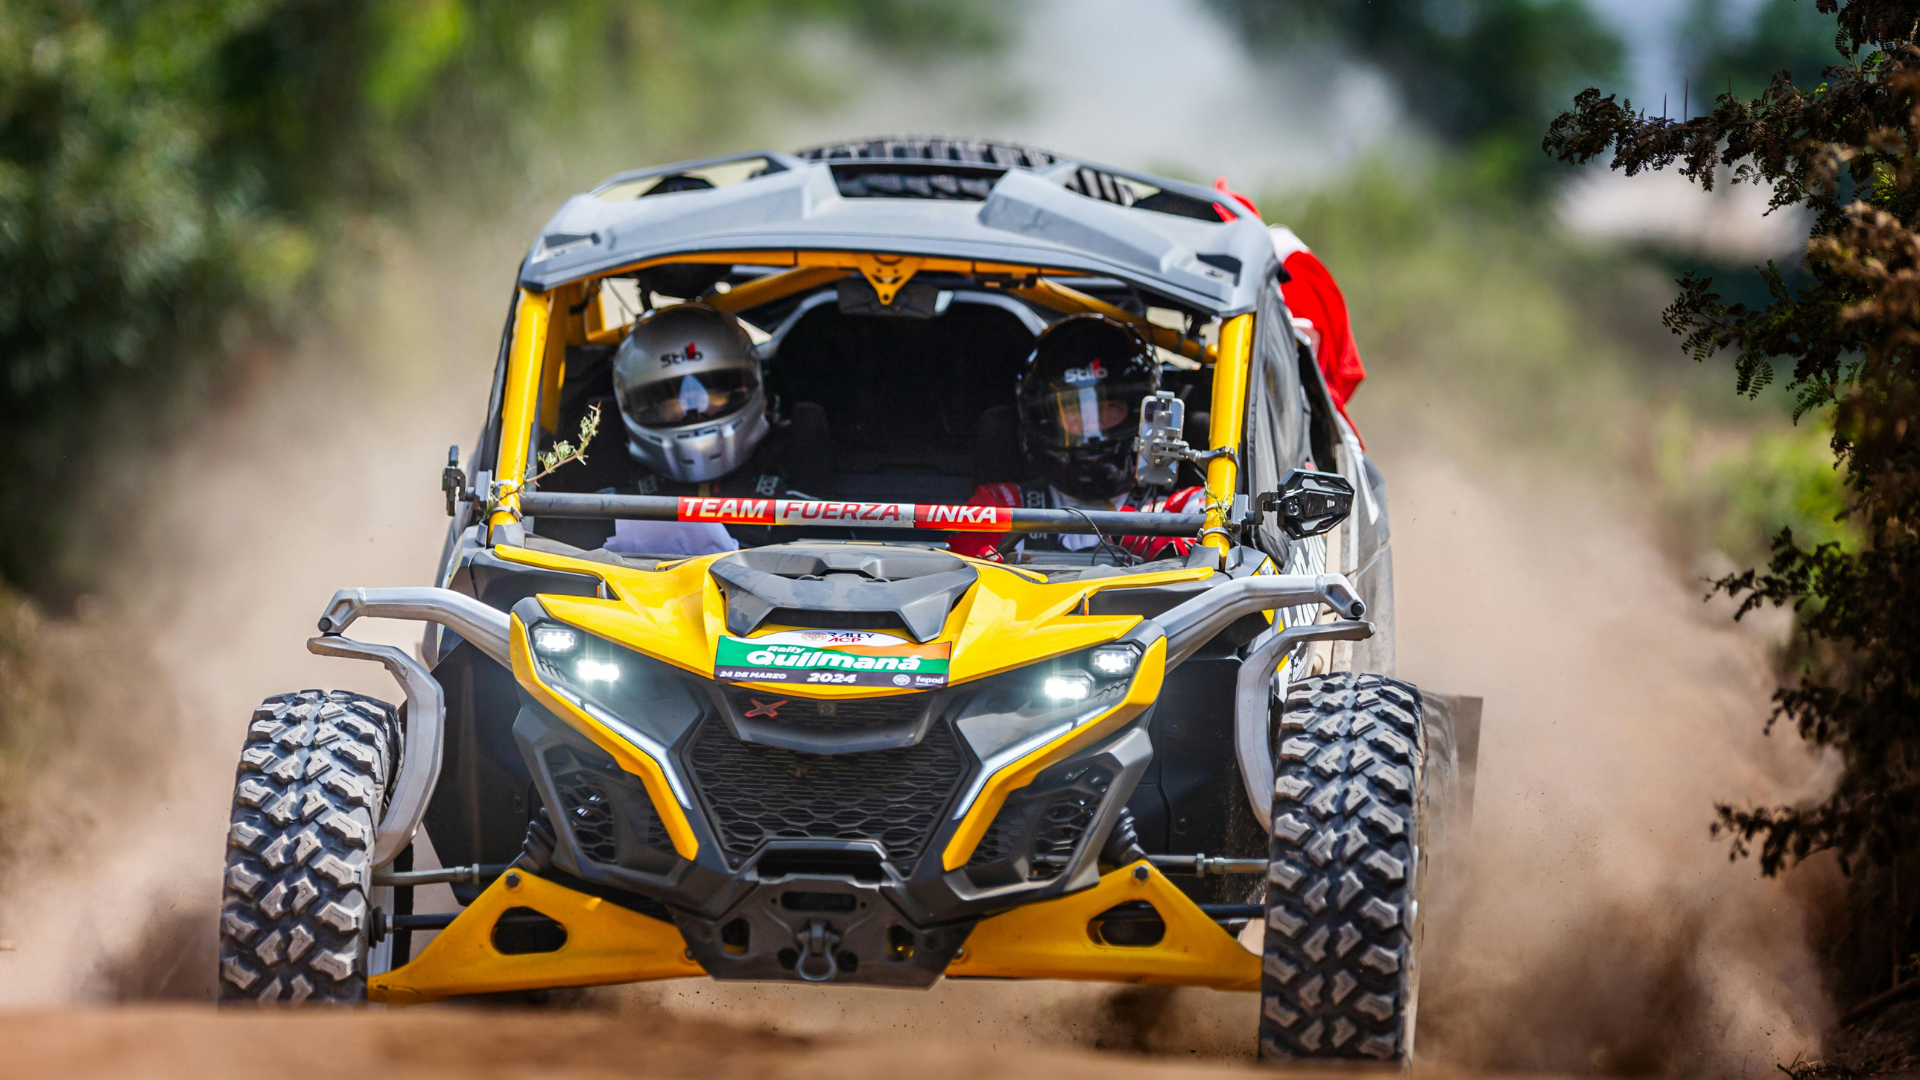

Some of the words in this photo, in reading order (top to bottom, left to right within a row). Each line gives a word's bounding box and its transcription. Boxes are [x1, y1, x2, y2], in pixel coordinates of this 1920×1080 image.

[683, 498, 768, 518] TEAM
[782, 502, 901, 521] FUERZA
[926, 504, 998, 524] INKA
[767, 645, 806, 654] Rally
[746, 650, 922, 671] Quilmaná
[807, 673, 858, 684] 2024
[916, 675, 944, 684] fepad
